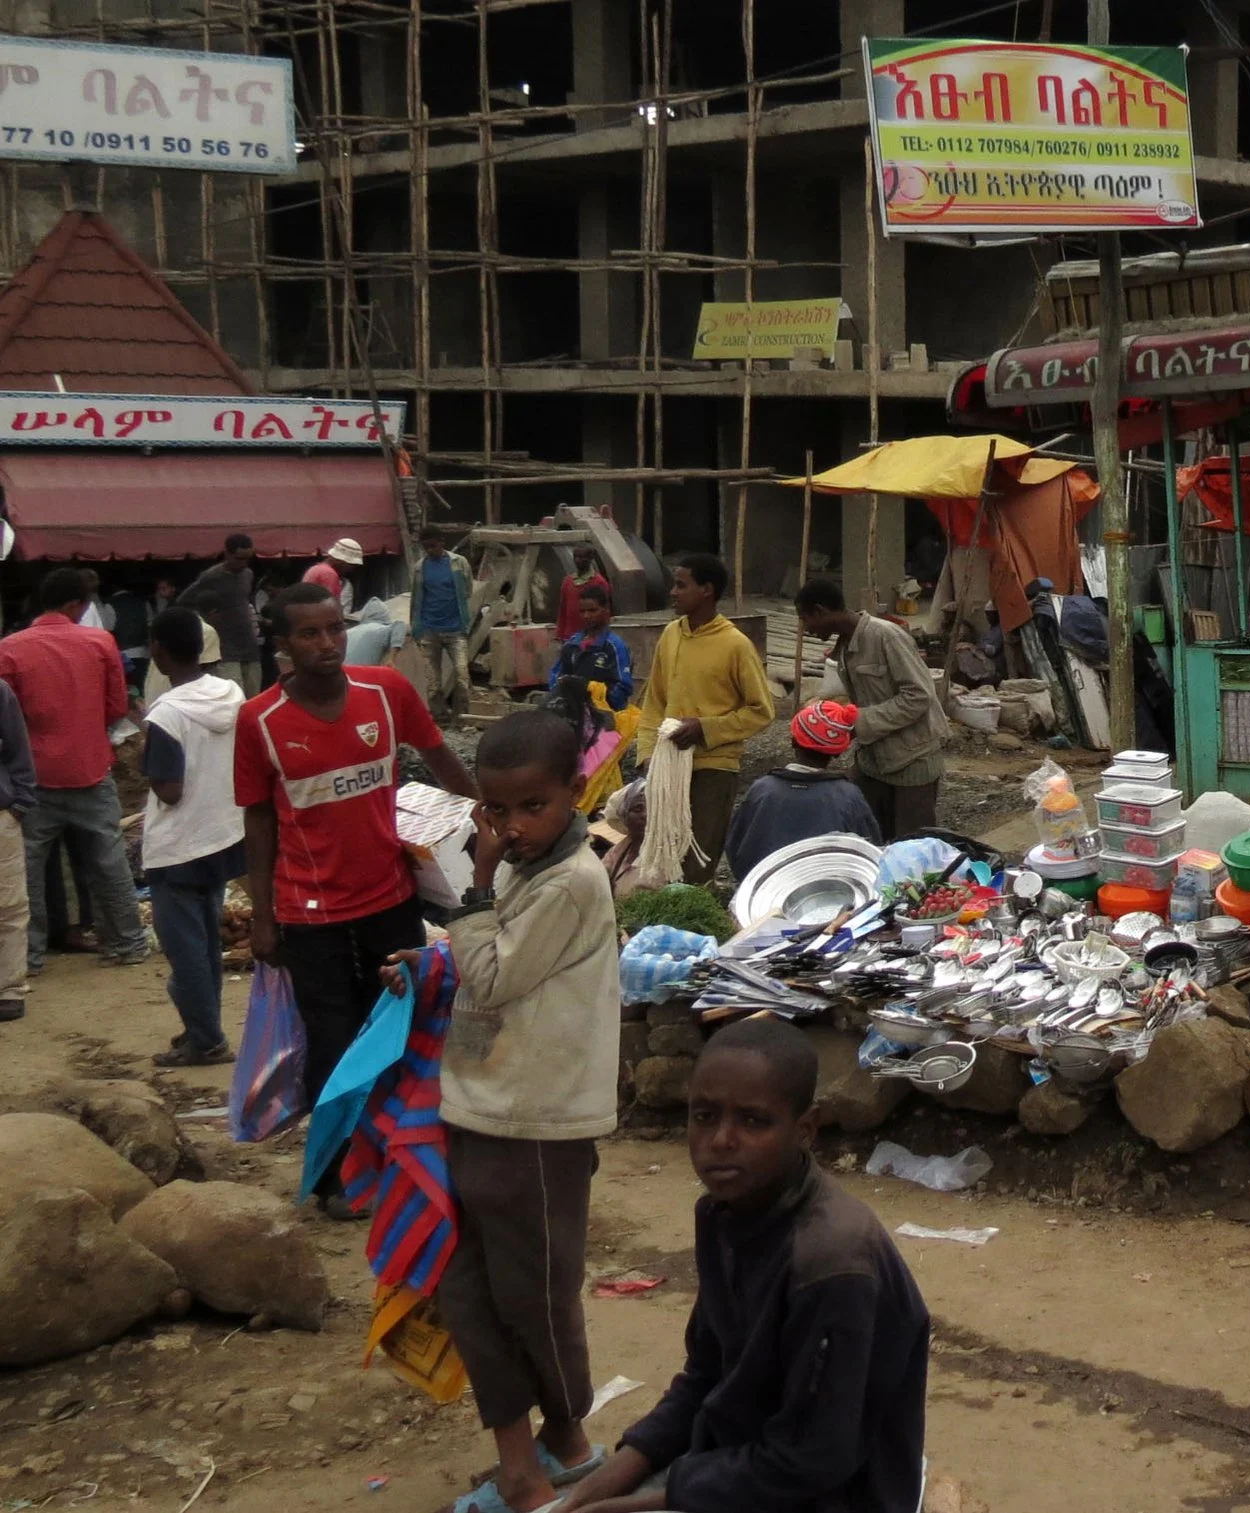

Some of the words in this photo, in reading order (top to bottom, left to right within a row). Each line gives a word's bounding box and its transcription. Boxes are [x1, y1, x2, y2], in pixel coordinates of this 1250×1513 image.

[82, 66, 273, 125] ባልትና
[1037, 72, 1168, 128] ባልትና
[44, 129, 75, 147] 10
[162, 137, 192, 154] 50
[201, 139, 231, 157] 56
[240, 141, 269, 159] 76
[937, 137, 973, 152] 0112
[1097, 141, 1128, 156] 0911
[1133, 143, 1180, 159] 238932
[213, 406, 392, 440] ባልትና
